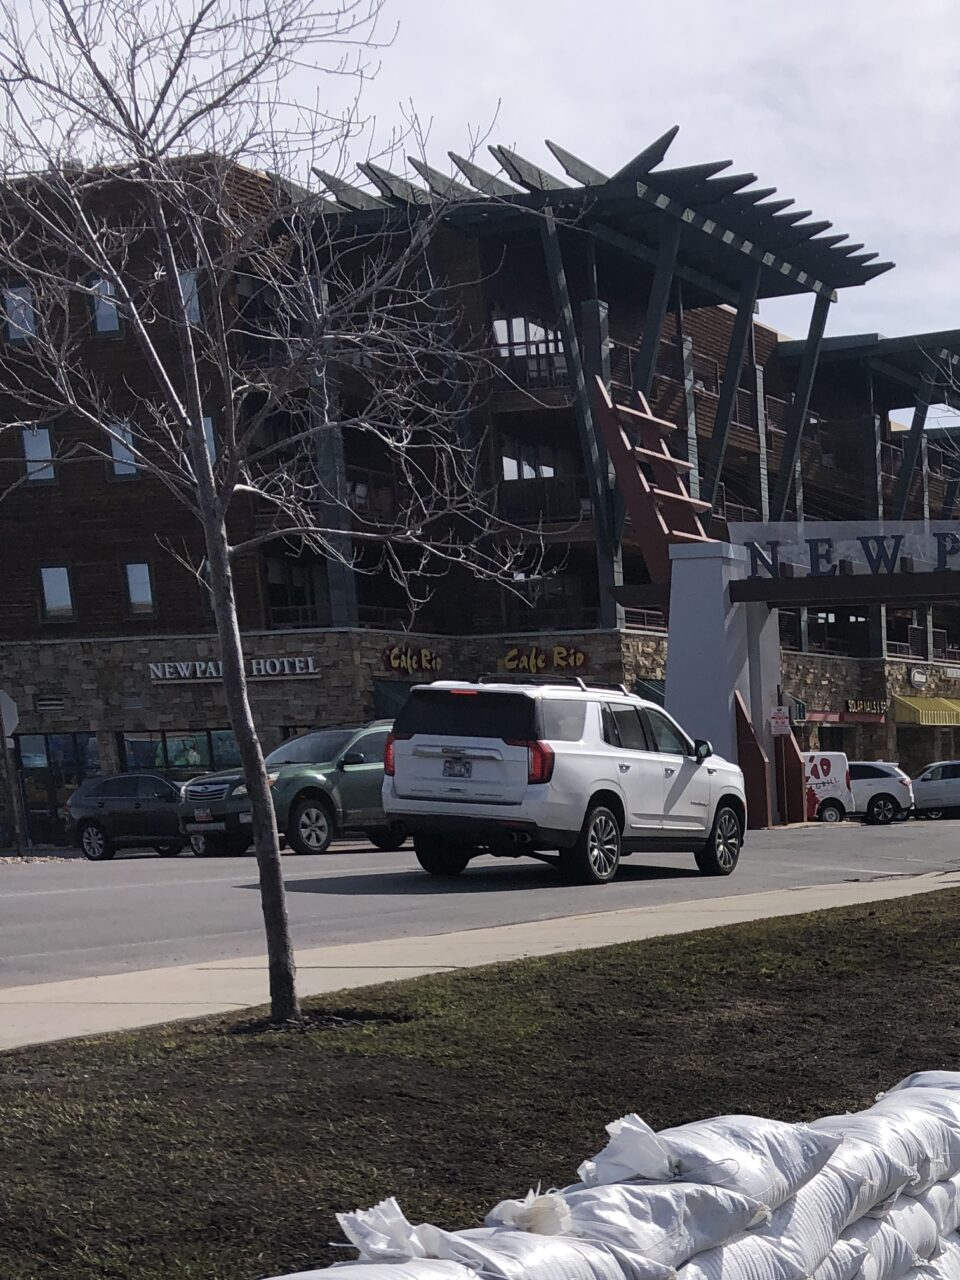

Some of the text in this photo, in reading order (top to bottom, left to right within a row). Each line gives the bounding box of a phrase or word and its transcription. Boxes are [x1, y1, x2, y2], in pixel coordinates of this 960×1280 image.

[149, 656, 321, 680] NEWPA HOTEL
[420, 648, 442, 671] Rio
[504, 645, 584, 674] Cafe Rio
